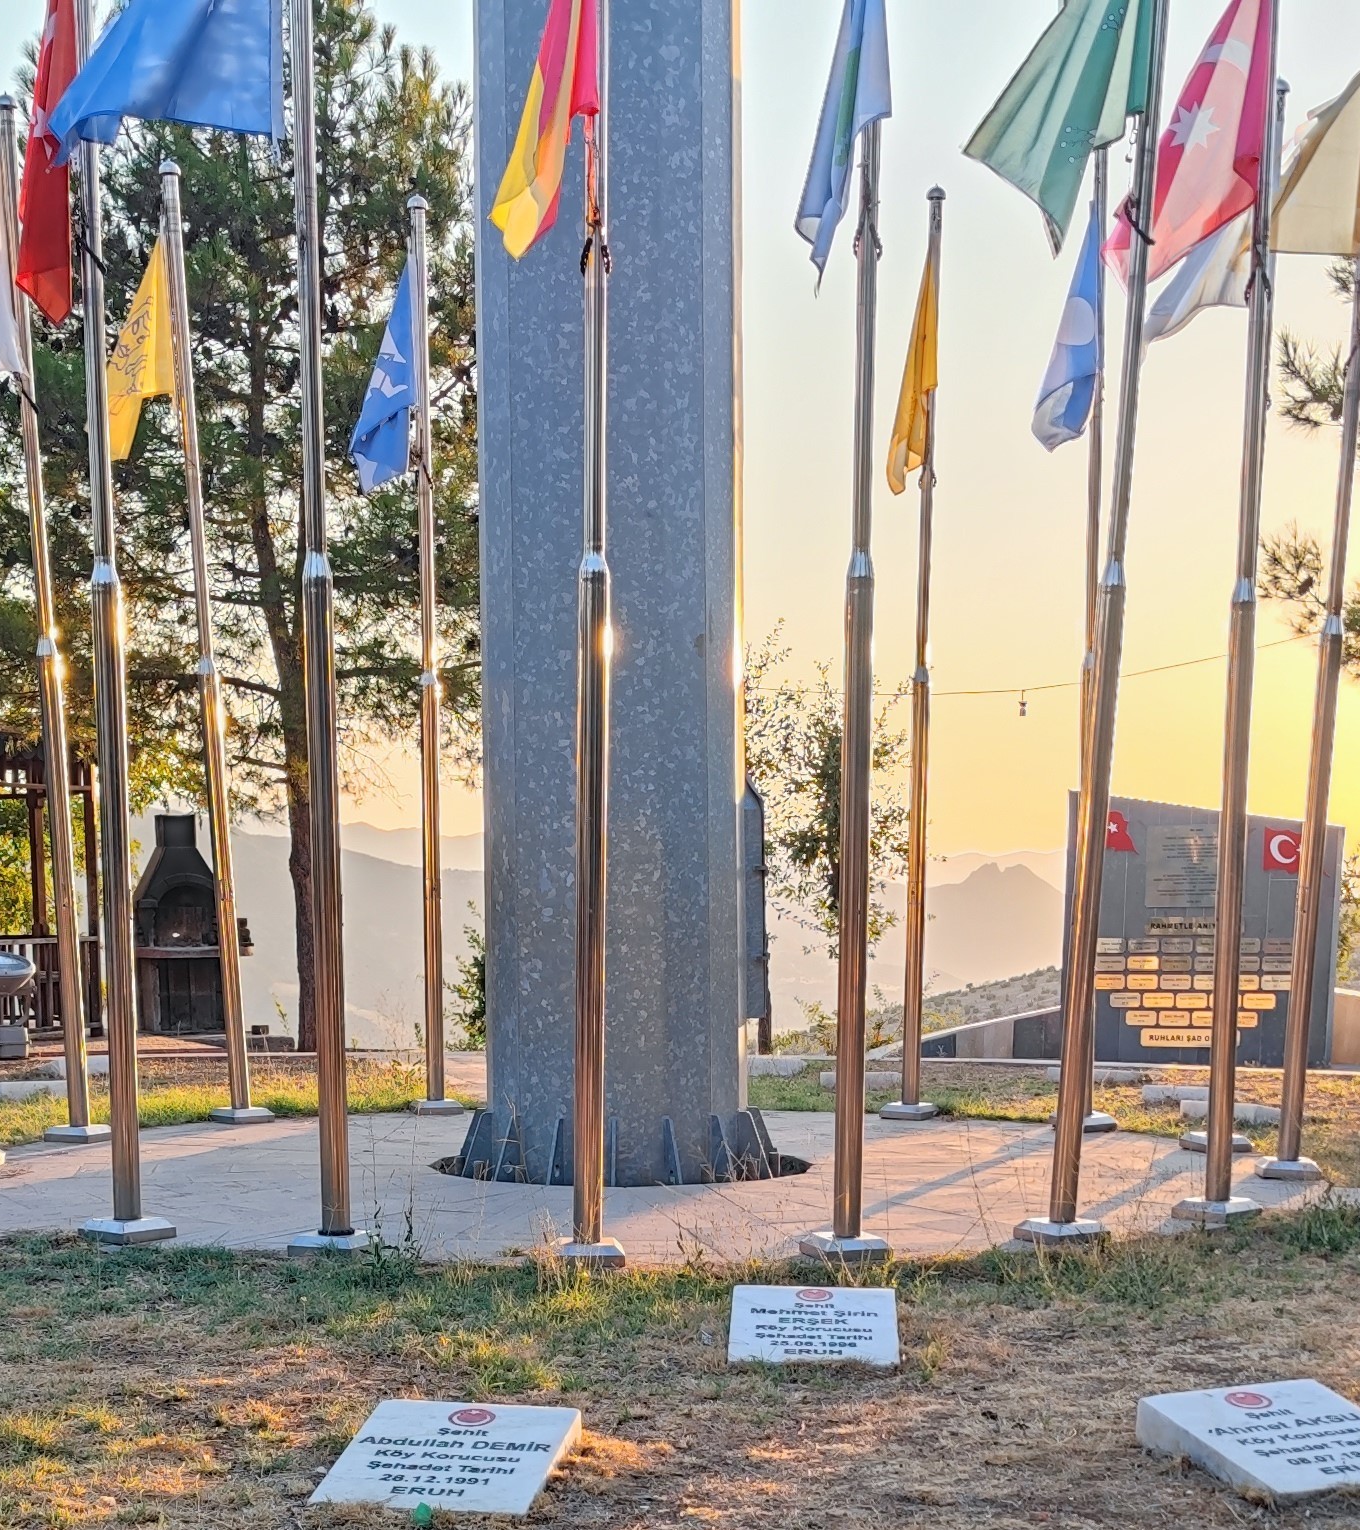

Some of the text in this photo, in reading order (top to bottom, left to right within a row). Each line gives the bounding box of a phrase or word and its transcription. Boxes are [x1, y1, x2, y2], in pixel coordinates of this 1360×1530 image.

[1150, 922, 1193, 930] RAHMETLE
[1148, 1034, 1184, 1042] RUHLARI
[750, 1307, 827, 1317] Mehmet
[778, 1316, 849, 1326] ERŞEK
[754, 1324, 873, 1333] Köy Korucusu
[754, 1332, 873, 1341] Şehadet Tarihi
[783, 1348, 843, 1356] ERUH
[1244, 1407, 1295, 1420] Şehit
[1294, 1412, 1360, 1427] AKSU
[436, 1427, 490, 1437] Şehit
[358, 1436, 552, 1453] Abdullah DEMİR
[1236, 1436, 1276, 1446] Köy
[1253, 1441, 1330, 1457] Şehadet
[374, 1449, 521, 1463] Köy Korucusu
[366, 1460, 516, 1475] Şehadet Tarihi
[389, 1485, 465, 1497] ERUH
